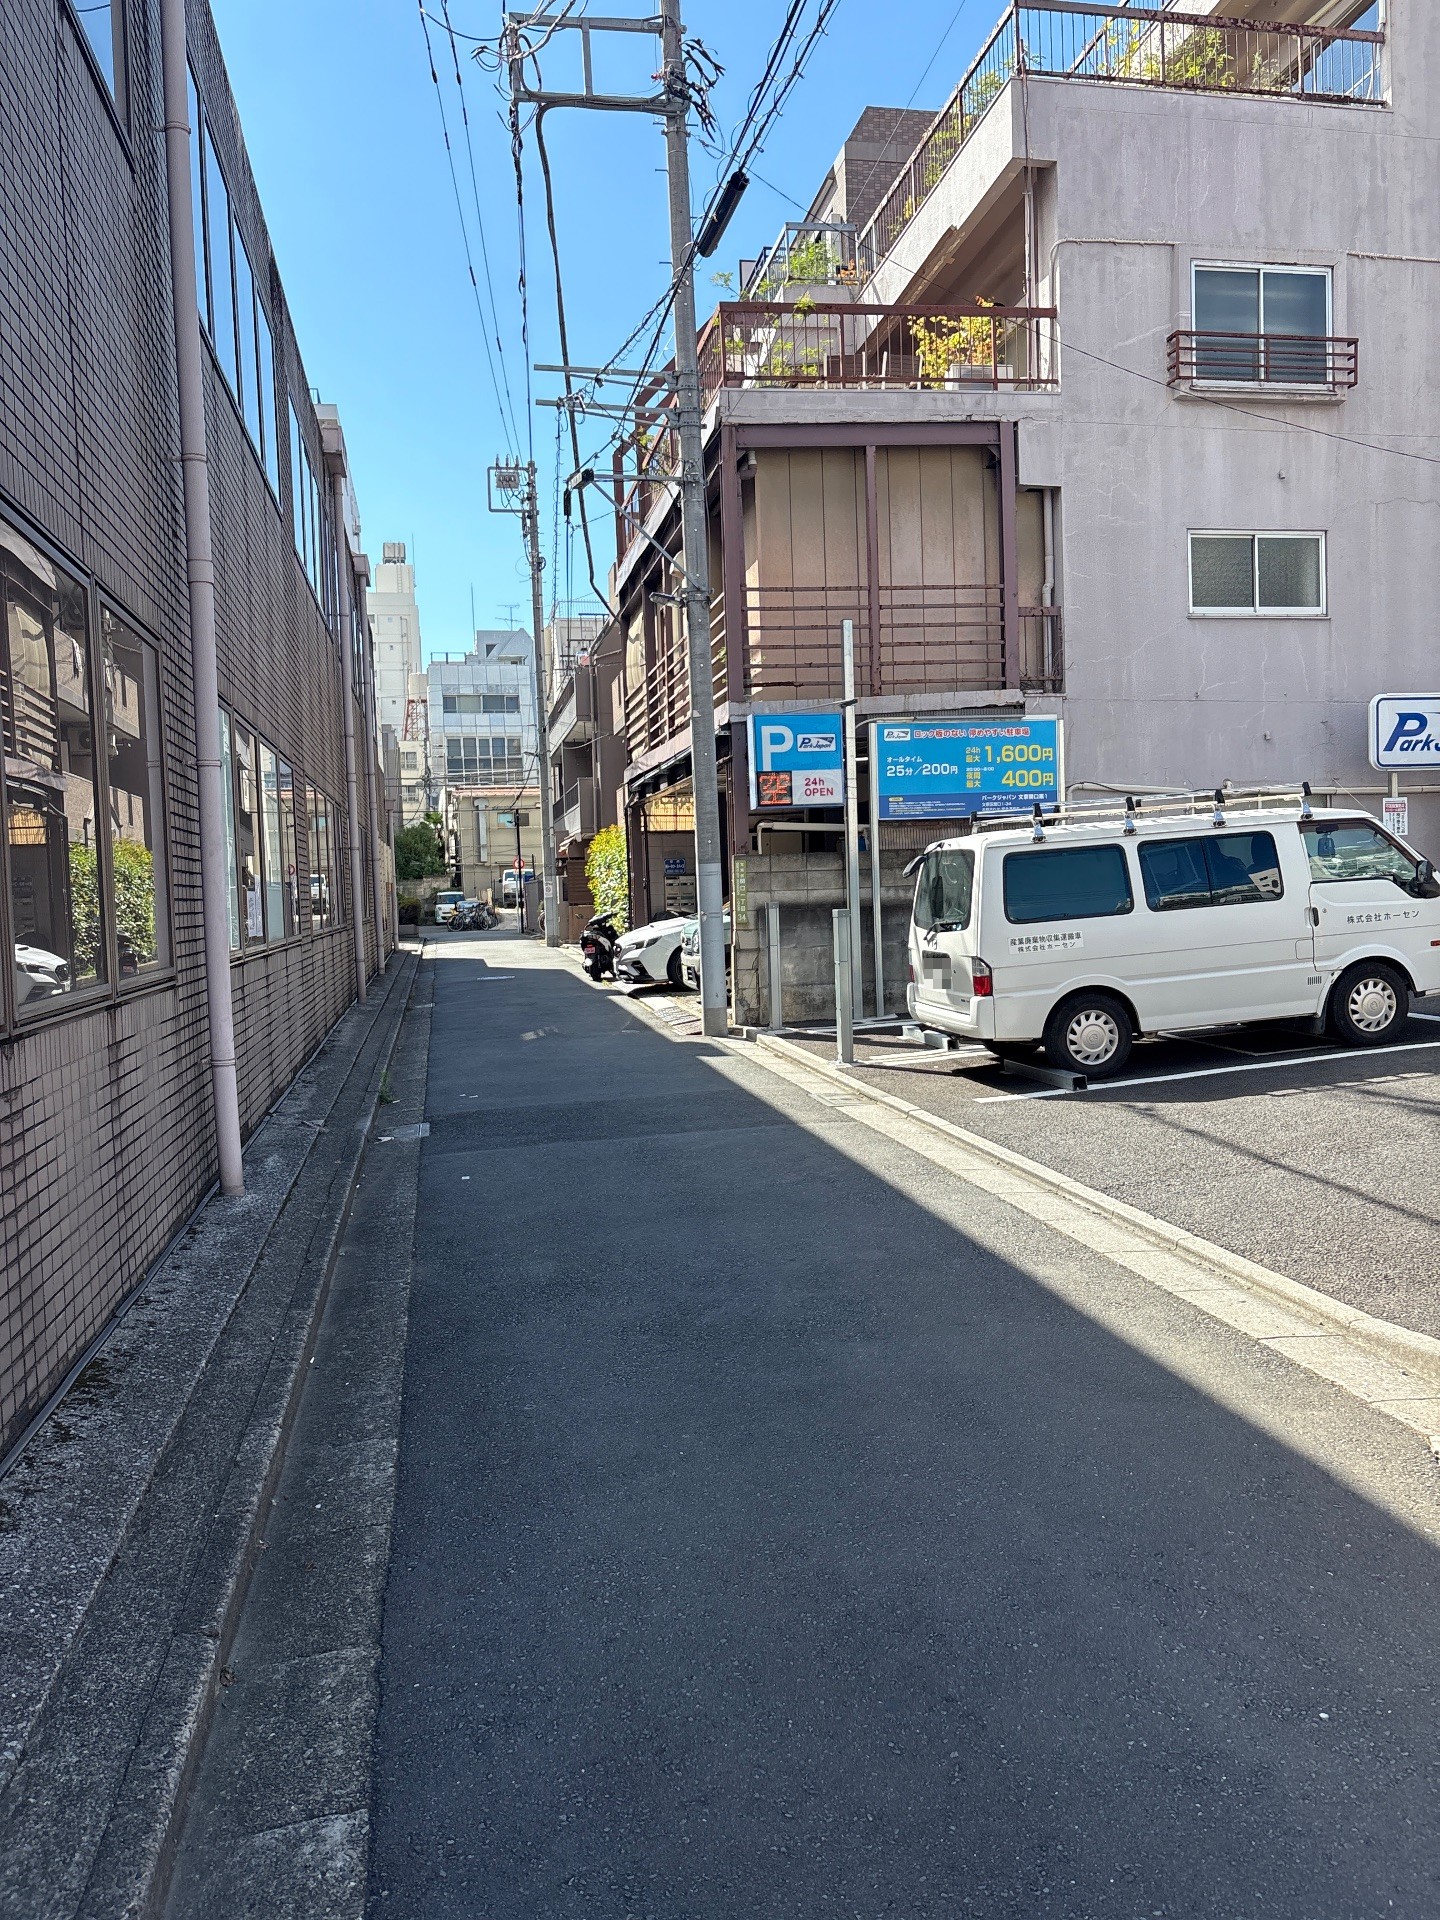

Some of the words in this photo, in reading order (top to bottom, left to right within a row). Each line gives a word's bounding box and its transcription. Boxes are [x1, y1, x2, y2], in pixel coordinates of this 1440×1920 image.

[913, 729, 967, 739] ロック板のない
[761, 725, 794, 771] P
[965, 746, 981, 754] 24h
[965, 755, 981, 763] 最大
[984, 744, 1053, 764] 1,600円
[804, 777, 825, 787] 24h
[1001, 769, 1054, 787] 400円
[804, 787, 834, 797] OPEN
[1347, 910, 1420, 924] 株式会社ホーセン
[1010, 932, 1081, 946] 産業廃棄物収集運搬車
